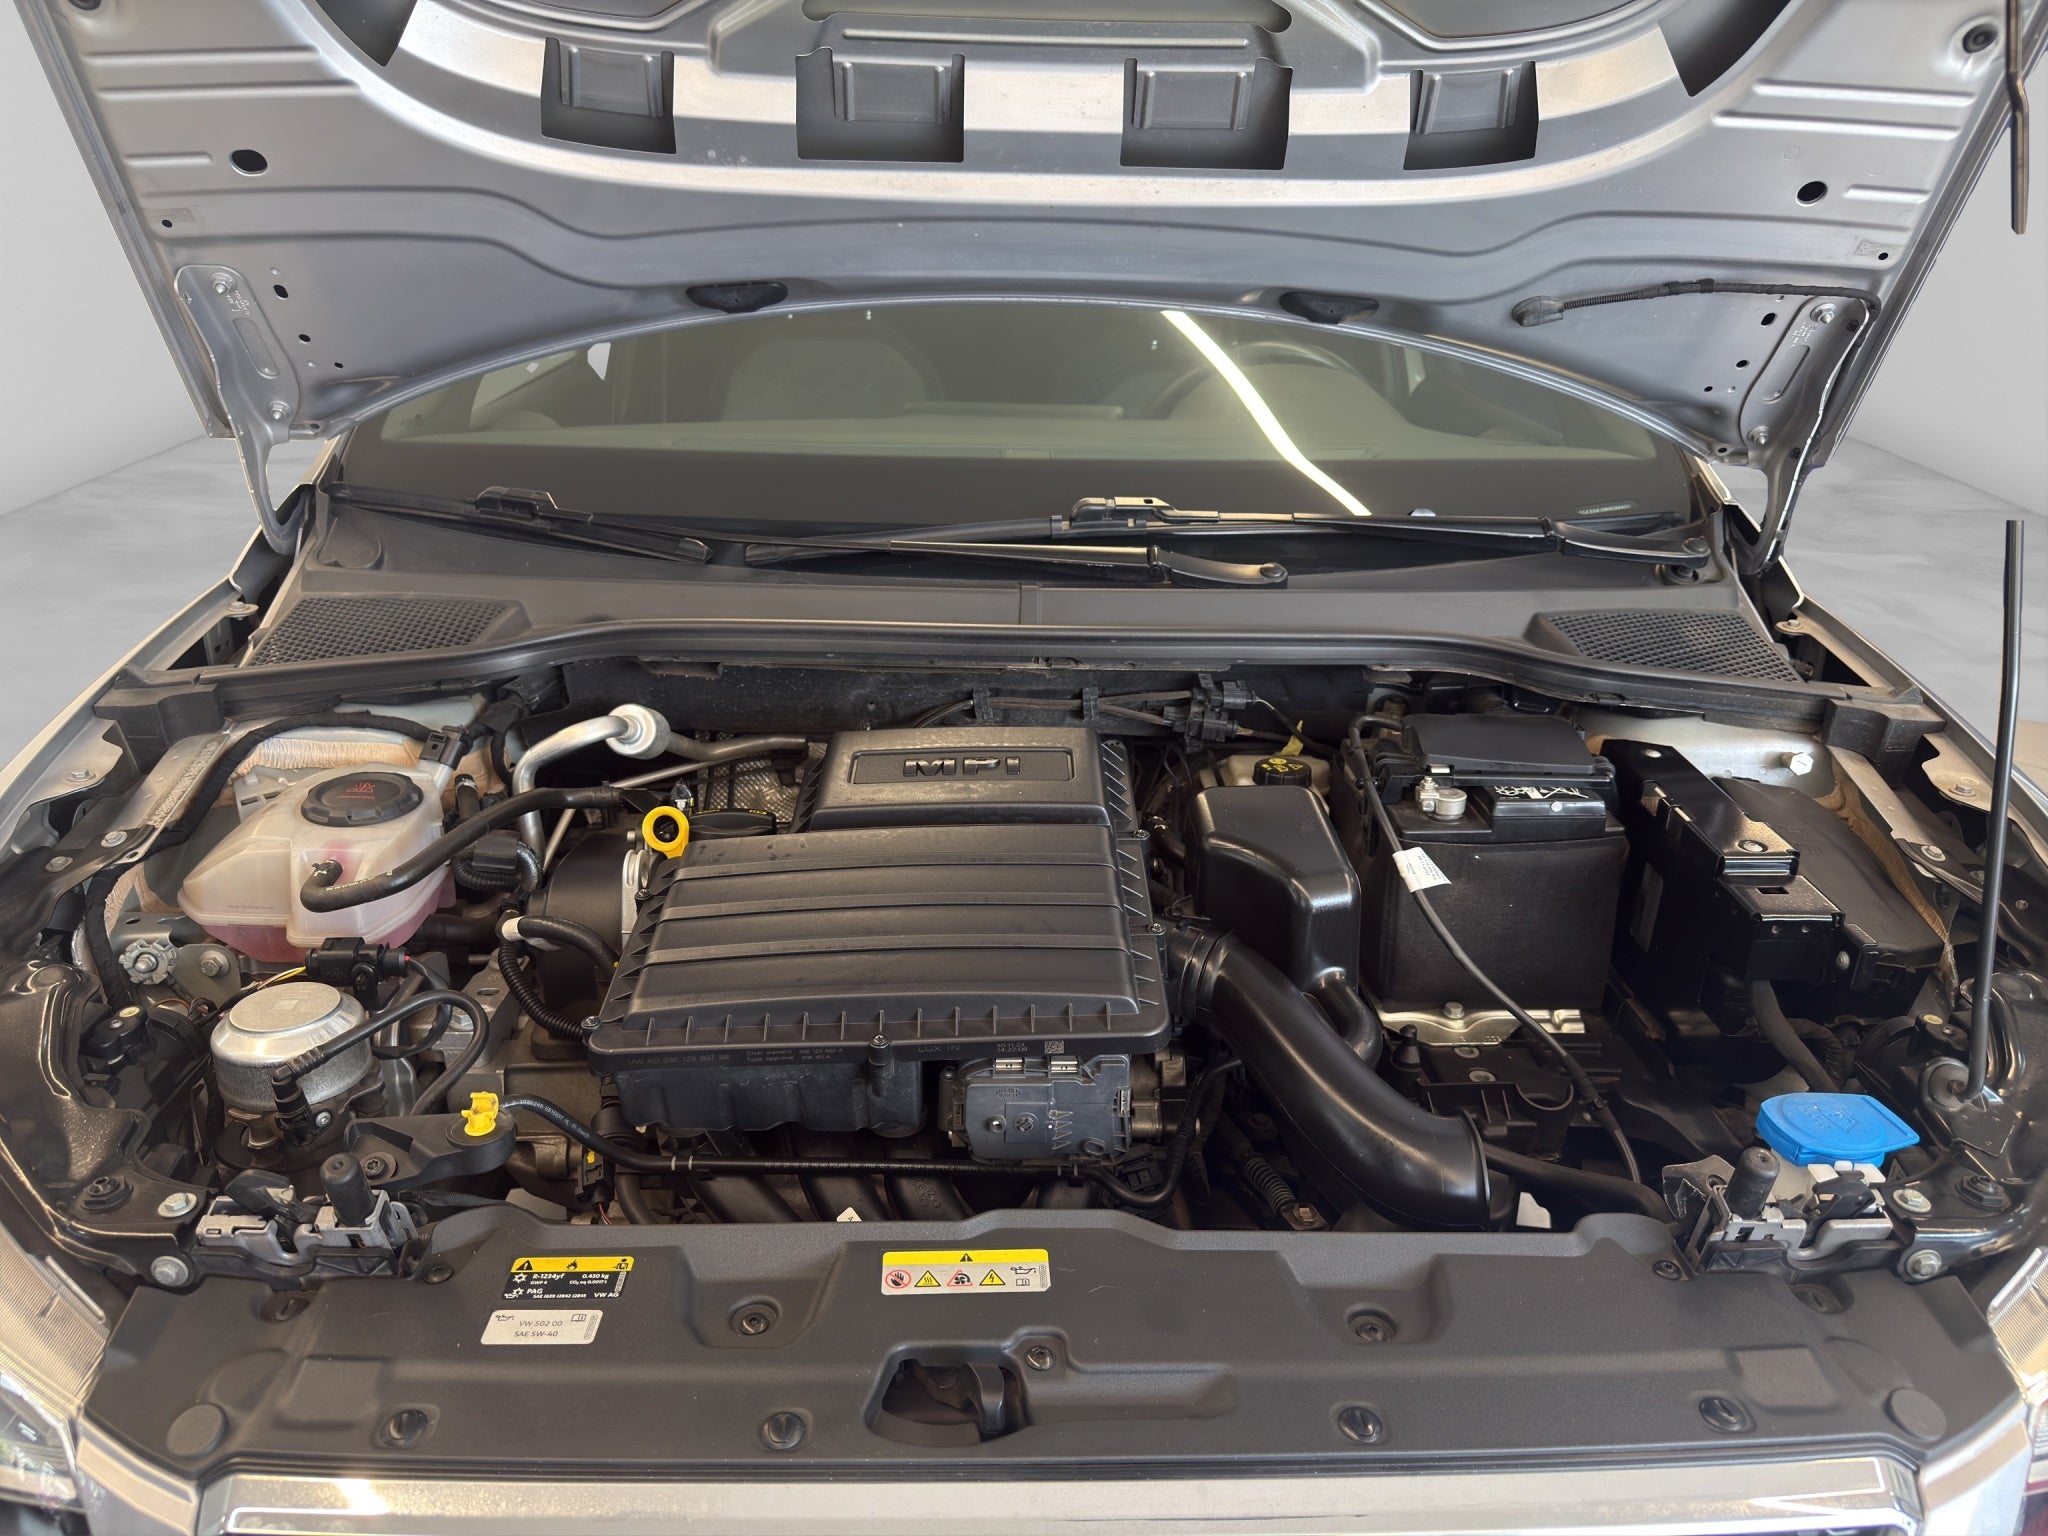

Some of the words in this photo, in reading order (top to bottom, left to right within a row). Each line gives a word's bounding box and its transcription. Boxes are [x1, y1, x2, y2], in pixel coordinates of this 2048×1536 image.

[903, 757, 1021, 777] MPI
[918, 1045, 942, 1053] LUX
[532, 1273, 566, 1281] R-1234yf
